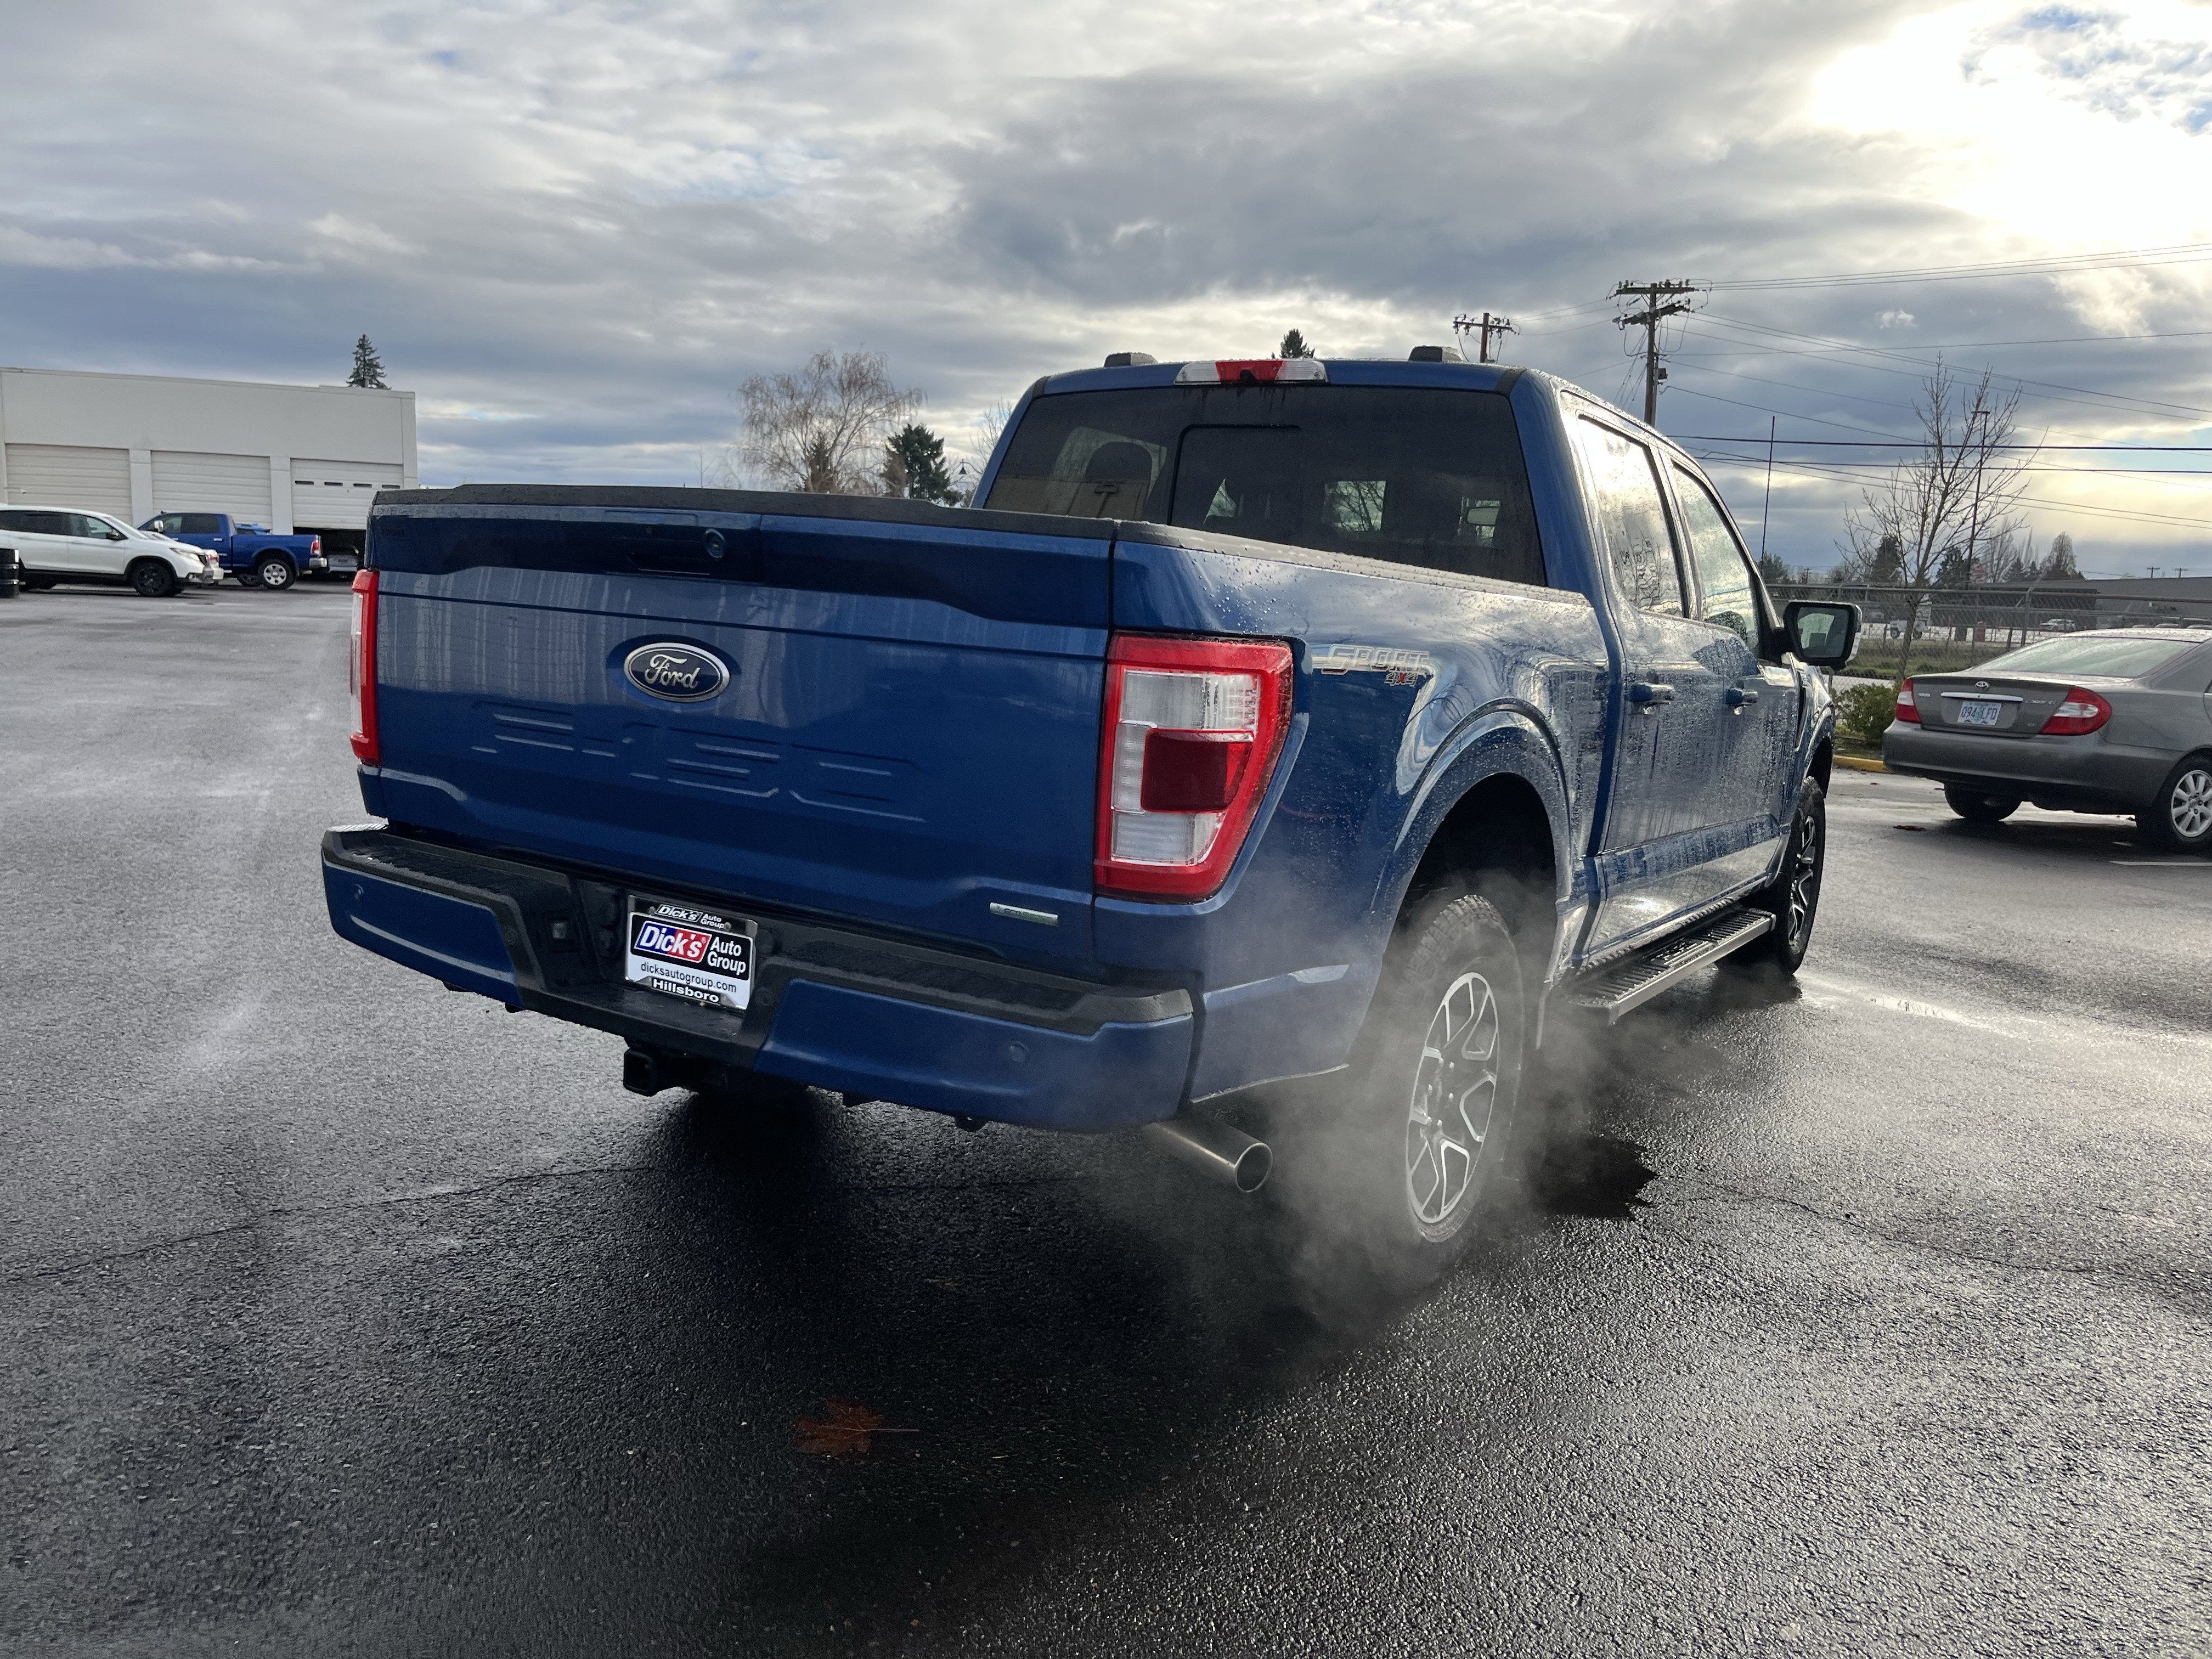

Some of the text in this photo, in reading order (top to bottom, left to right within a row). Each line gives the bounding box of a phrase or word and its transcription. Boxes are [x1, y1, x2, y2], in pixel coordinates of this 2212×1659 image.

[645, 654, 701, 689] Ford
[1321, 644, 1429, 675] SPORT
[470, 699, 927, 823] F-150
[658, 906, 722, 922] Dick's Auto
[701, 918, 725, 929] Group
[639, 926, 741, 958] Dick's Auto
[641, 962, 737, 992] dicksautogroup.com
[707, 951, 746, 975] Group
[653, 979, 719, 1003] Hillsboro
